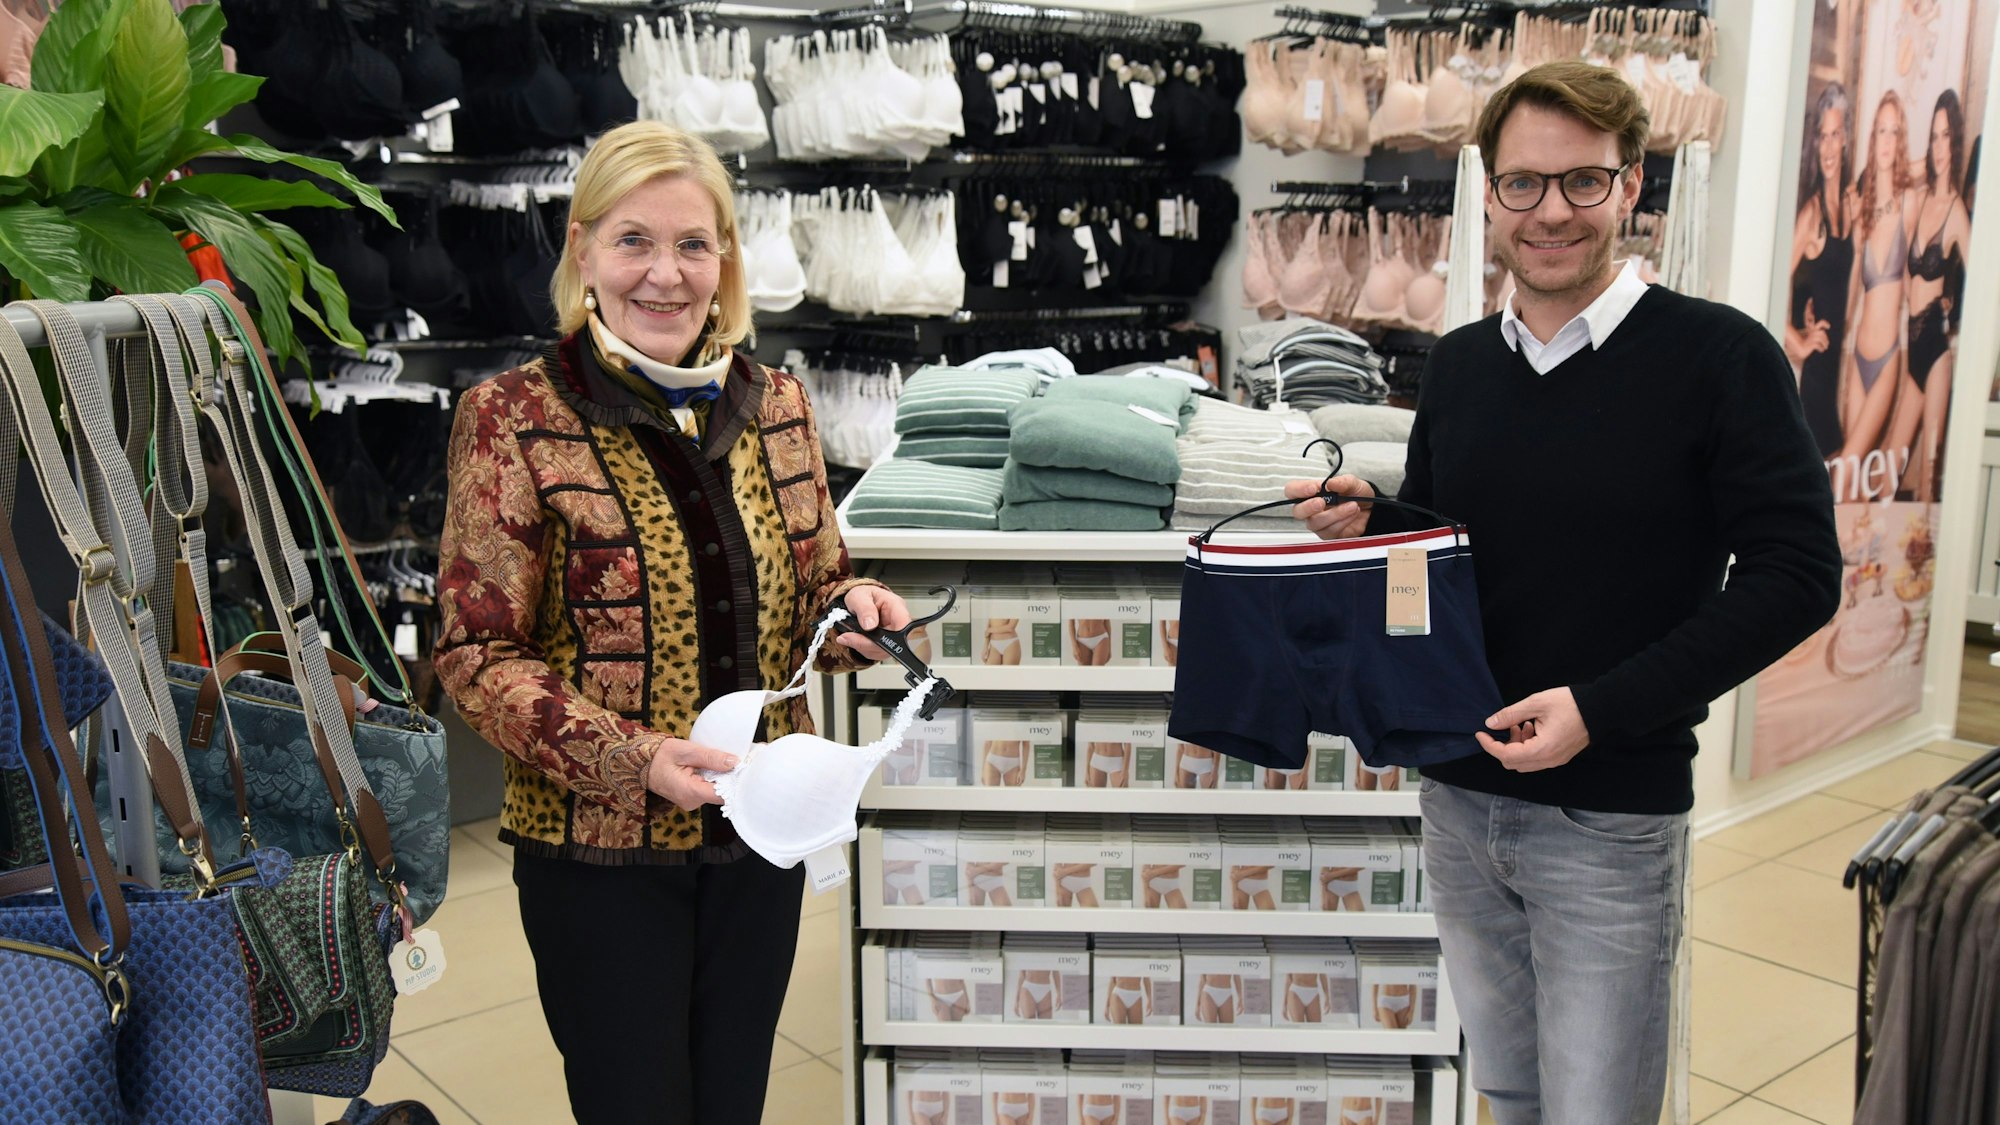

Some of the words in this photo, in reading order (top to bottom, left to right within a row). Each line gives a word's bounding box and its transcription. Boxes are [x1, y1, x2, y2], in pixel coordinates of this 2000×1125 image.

[1391, 586, 1420, 596] mey
[1027, 605, 1051, 614] mey
[1118, 605, 1142, 614] mey
[880, 635, 897, 650] MARIE
[894, 646, 904, 654] JO
[924, 725, 946, 735] mey
[1029, 726, 1053, 736] mey
[1132, 729, 1155, 738] mey
[924, 847, 946, 856] mey
[1012, 849, 1035, 858] mey
[1100, 850, 1124, 859] mey
[1189, 852, 1212, 860] mey
[1278, 852, 1301, 861] mey
[1369, 853, 1392, 862] mey
[818, 872, 836, 883] MARIE
[838, 868, 846, 876] JO
[1058, 956, 1080, 965] mey
[1239, 960, 1262, 969] mey
[1324, 959, 1347, 968] mey
[970, 966, 993, 975] mey
[1149, 964, 1171, 972] mey
[950, 1078, 972, 1087] mey
[1036, 1080, 1058, 1089] mey
[1121, 1081, 1144, 1090] mey
[1208, 1083, 1231, 1092] mey
[1296, 1084, 1318, 1093] mey
[1382, 1084, 1405, 1093] mey
